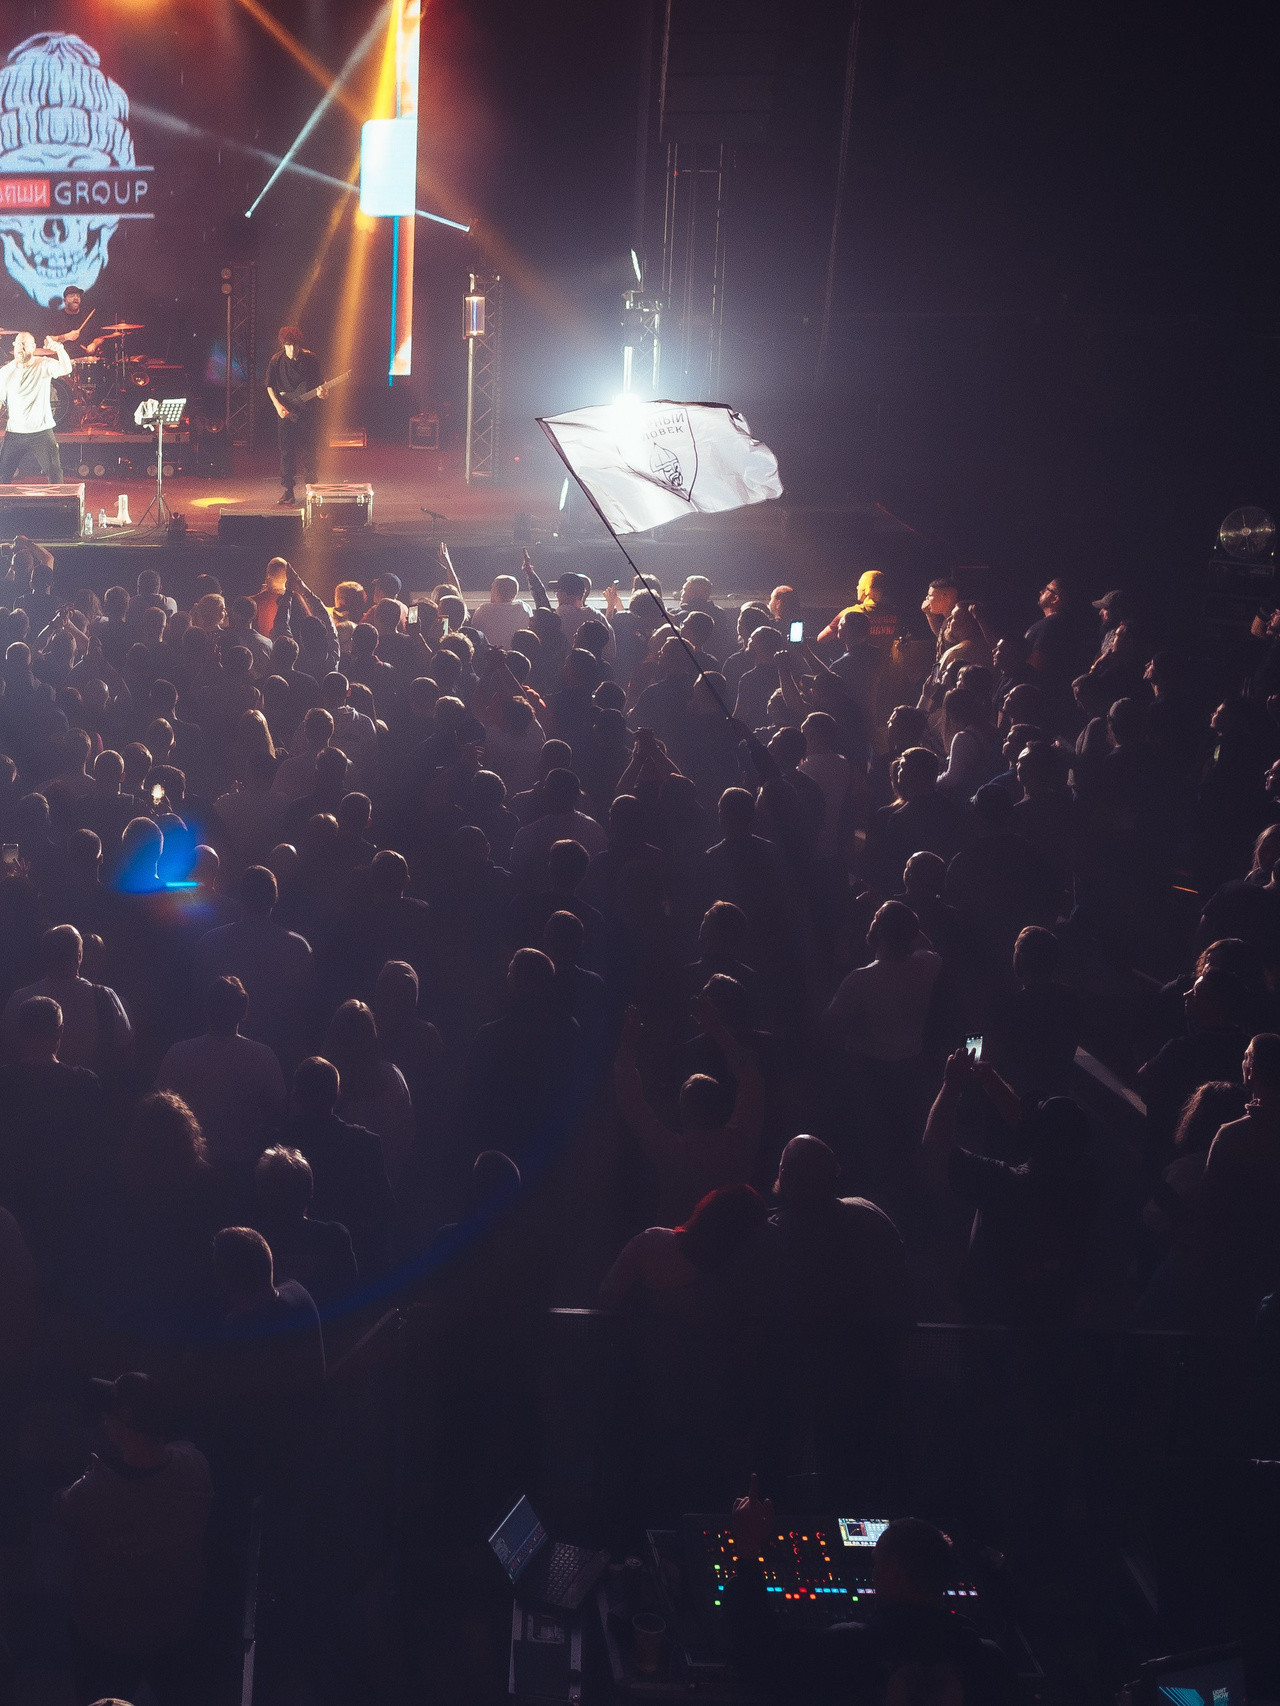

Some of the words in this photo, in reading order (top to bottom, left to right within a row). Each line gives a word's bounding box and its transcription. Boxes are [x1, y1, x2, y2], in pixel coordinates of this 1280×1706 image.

[54, 180, 148, 205] GROUP
[647, 411, 685, 428] РНЫЙ
[642, 425, 685, 441] ЛОВЕК
